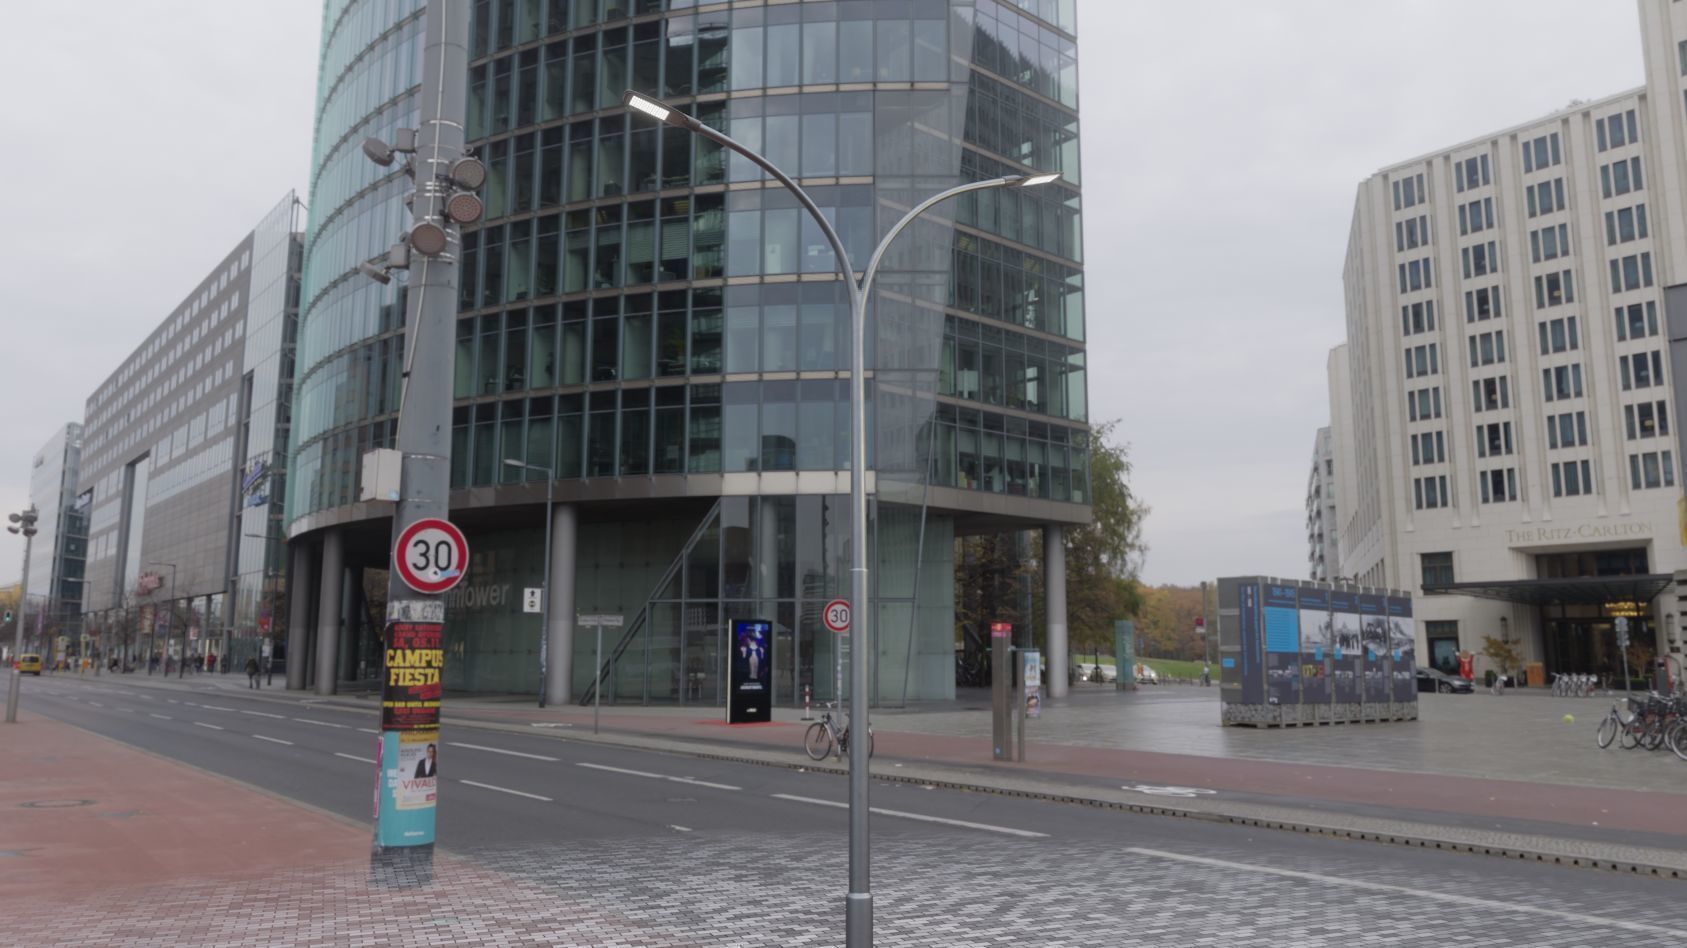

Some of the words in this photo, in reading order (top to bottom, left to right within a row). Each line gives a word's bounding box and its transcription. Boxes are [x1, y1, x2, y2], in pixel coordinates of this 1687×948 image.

[1505, 528, 1534, 544] THE
[412, 539, 453, 571] 30
[830, 609, 848, 624] 30
[386, 649, 444, 667] CAMPUS
[389, 668, 440, 686] FIESTA
